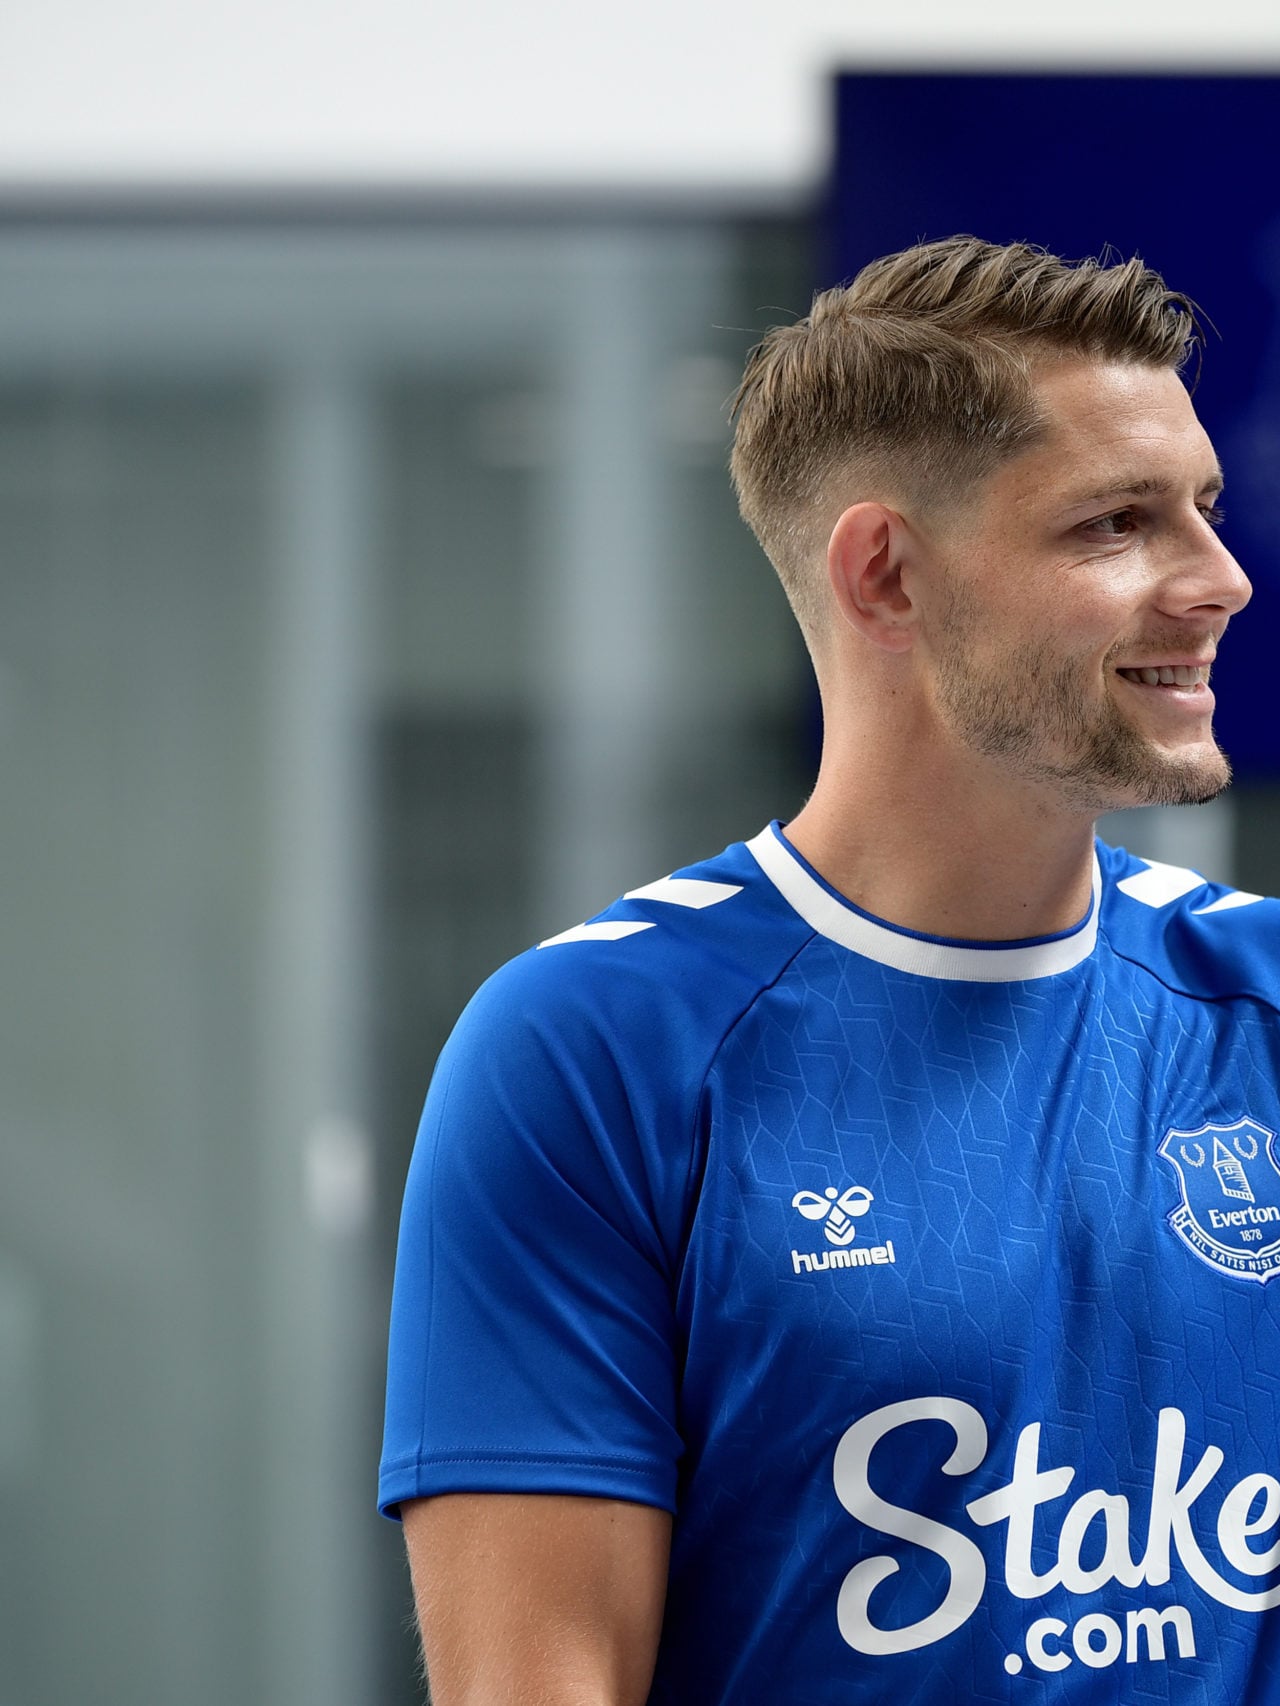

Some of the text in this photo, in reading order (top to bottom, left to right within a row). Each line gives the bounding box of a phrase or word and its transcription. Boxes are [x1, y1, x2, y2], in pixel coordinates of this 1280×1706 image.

[1208, 1206, 1280, 1228] Everton
[1189, 1231, 1207, 1253] NIL
[1210, 1250, 1245, 1270] SATIS
[1248, 1259, 1273, 1271] NISI
[1240, 1229, 1263, 1242] 1878
[791, 1240, 895, 1274] hummel
[1004, 1605, 1196, 1675] .com
